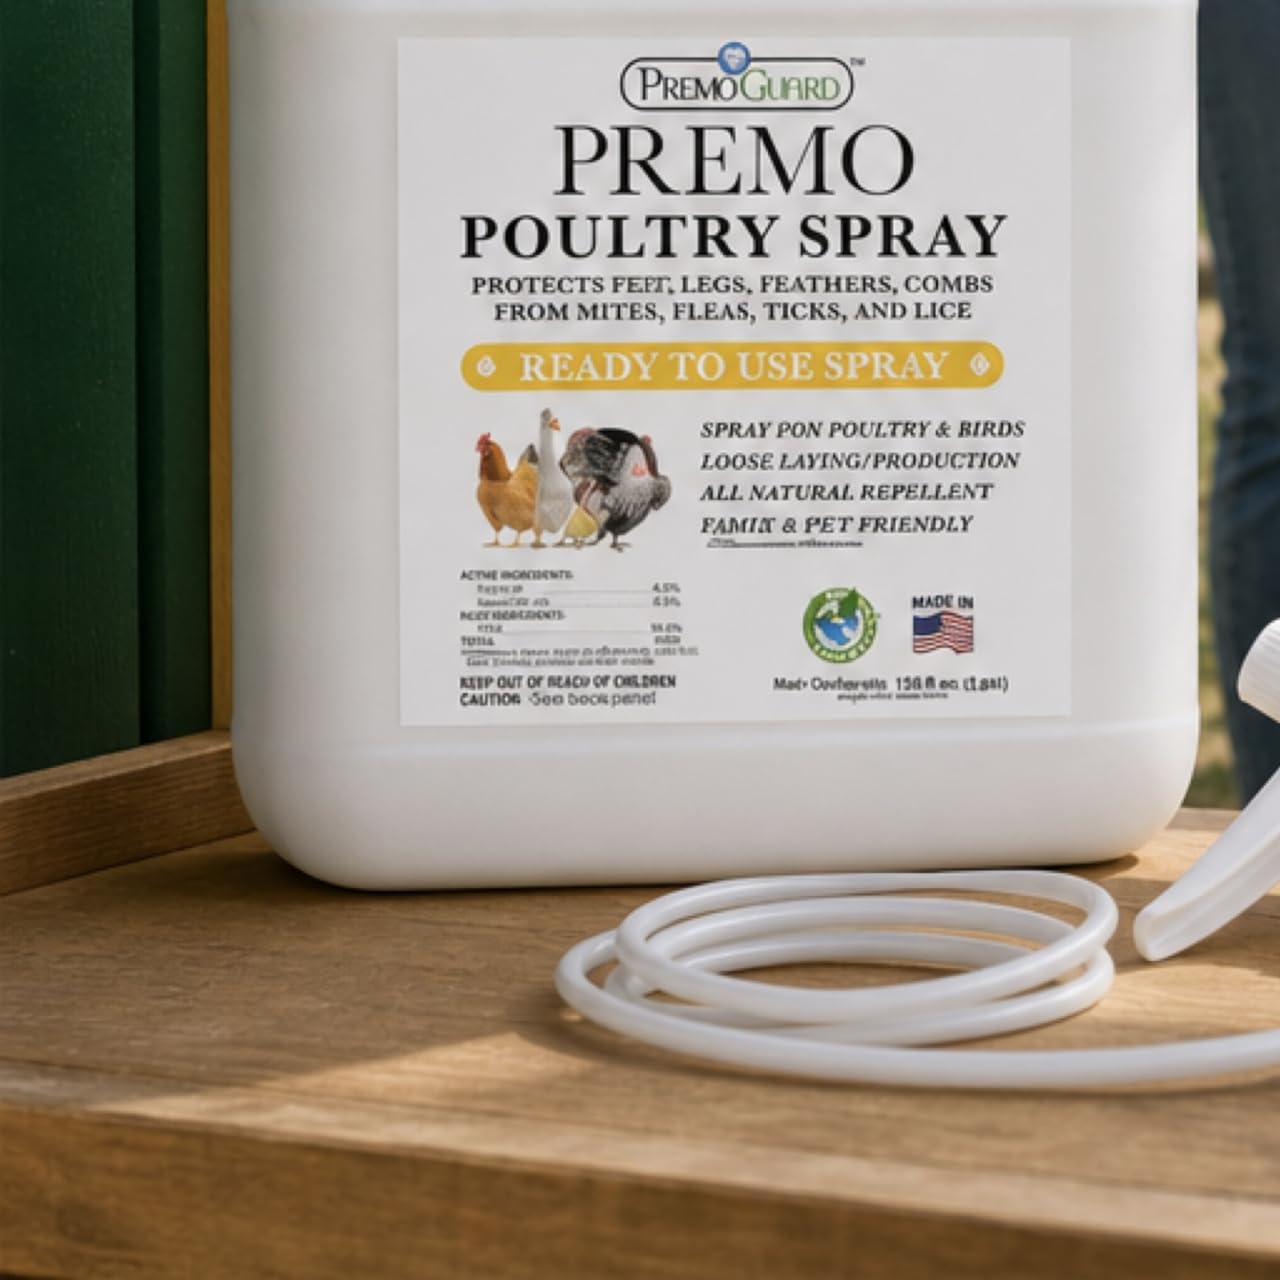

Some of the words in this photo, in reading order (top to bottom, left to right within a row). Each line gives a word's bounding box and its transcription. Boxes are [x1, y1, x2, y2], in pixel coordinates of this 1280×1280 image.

[552, 123, 915, 196] PREMO
[459, 214, 781, 261] POULTRY
[798, 213, 1009, 259] SPRAY
[471, 274, 606, 296] PROTECTS
[679, 274, 754, 296] LEGS,
[759, 274, 899, 297] FEATHERS,
[902, 273, 994, 294] COMBS
[493, 301, 570, 322] FROM
[576, 301, 666, 326] MITES,
[672, 301, 757, 326] FLEAS,
[761, 301, 849, 325] TICKS,
[853, 301, 908, 321] AND
[913, 300, 973, 321] LICE
[519, 351, 659, 382] READY
[668, 351, 726, 381] TO
[737, 351, 814, 381] USE
[824, 351, 950, 381] SPRAY
[699, 420, 773, 439] SPRAY
[827, 419, 932, 439] POULTRY
[934, 419, 952, 439] &
[957, 419, 1027, 439] BIRDS
[699, 451, 775, 471] LOOSE
[778, 451, 1022, 471] LAYING/PRODUCTION
[699, 483, 744, 502] ALL
[747, 482, 855, 502] NATURAL
[859, 482, 996, 502] REPELLENT
[803, 515, 855, 535] PET
[857, 514, 975, 534] FRIENDLY
[911, 593, 955, 610] MADE
[956, 594, 975, 610] IN
